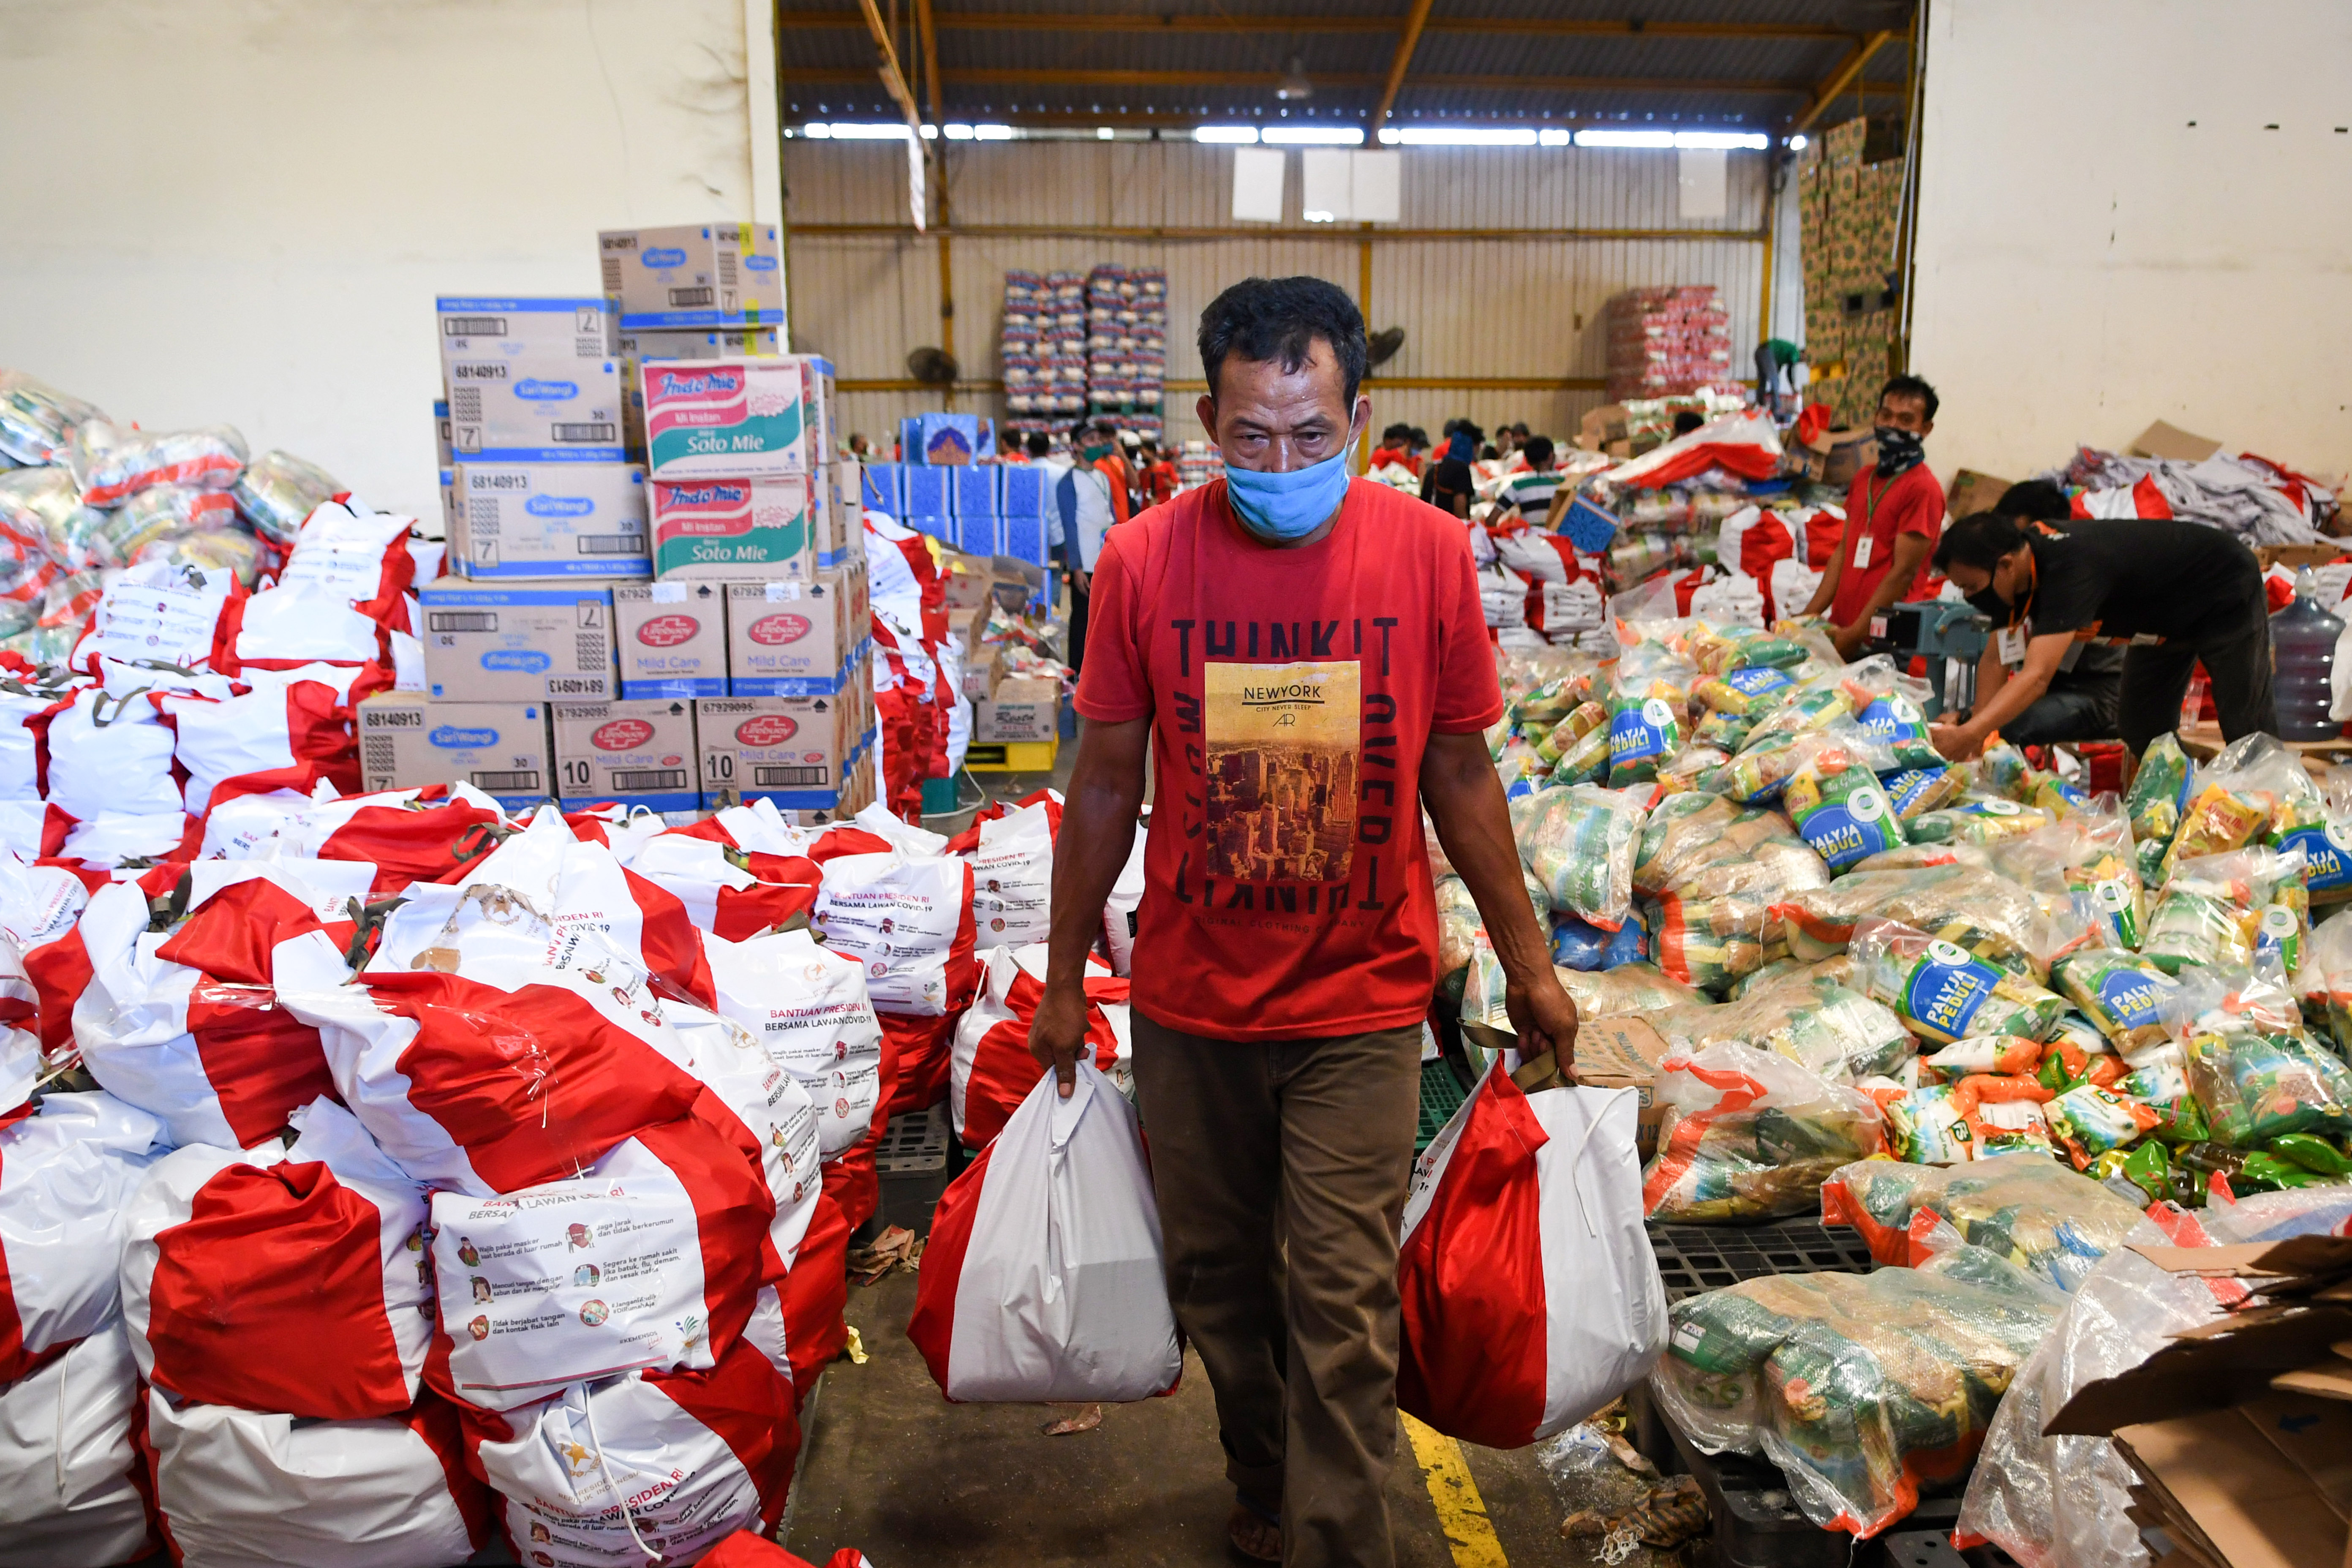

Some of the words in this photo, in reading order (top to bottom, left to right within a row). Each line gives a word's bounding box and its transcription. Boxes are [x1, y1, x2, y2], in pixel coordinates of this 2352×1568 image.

[455, 365, 507, 378] 68140913
[462, 428, 475, 445] 7
[687, 436, 727, 453] Soto
[732, 435, 765, 451] Mie
[471, 475, 528, 489] 68140913
[619, 521, 634, 532] 30
[479, 541, 492, 559] 7
[692, 546, 731, 561] Soto
[735, 546, 768, 561] Mie
[733, 587, 765, 596] 67929
[584, 608, 597, 626] 7
[637, 658, 666, 669] Mild
[669, 656, 701, 669] Care
[747, 655, 776, 667] Mild
[780, 655, 811, 667] Care
[548, 679, 603, 693] 68140913
[703, 702, 754, 713] 67929095
[366, 712, 422, 727] 68140913
[514, 758, 528, 768] 30
[564, 761, 589, 784] 10
[595, 754, 622, 765] Mild
[624, 754, 653, 764] Care
[707, 754, 732, 779] 10
[739, 749, 765, 760] Mild
[768, 749, 796, 760] Care
[373, 779, 388, 791] 7
[1819, 833, 1863, 858] EDULI
[2307, 849, 2338, 866] YJA
[972, 863, 995, 871] AWAN
[997, 860, 1031, 868] COVID-19
[2308, 860, 2341, 877] DULI
[879, 893, 918, 903] PRESIDEN
[829, 899, 866, 909] BERSAMA
[897, 902, 933, 912] COVID-19
[1192, 915, 1240, 926] RIGINAL
[1250, 919, 1309, 934] CLOTHING
[1926, 970, 1968, 1023] PALYJA
[1938, 974, 1979, 1029] PEDULI
[2111, 984, 2159, 1008] PALY
[770, 1007, 822, 1018] BANTUAN
[824, 1003, 860, 1014] PRESIDEN
[765, 1020, 809, 1031] BERSAMA
[768, 1083, 786, 1107] BERSAMA
[610, 1186, 625, 1198] RI
[526, 1195, 577, 1209] LAWAN
[613, 1225, 631, 1234] tidak
[632, 1218, 674, 1231] berkerumun
[614, 1218, 632, 1229] jarak
[477, 1244, 494, 1253] Wajib
[495, 1242, 512, 1252] pakai
[514, 1238, 539, 1248] masker
[493, 1250, 515, 1259] berada
[524, 1246, 538, 1254] luar
[539, 1240, 563, 1251] rumah
[603, 1259, 627, 1269] Segera
[639, 1251, 660, 1261] rumah
[662, 1247, 678, 1257] sakit
[603, 1268, 616, 1277] jika
[618, 1263, 640, 1273] batuk,
[620, 1271, 639, 1279] sesak
[536, 1275, 564, 1285] dengan
[532, 1283, 561, 1293] mengalir
[613, 1301, 655, 1314] #DiRumahAja
[510, 1317, 539, 1328] berjabat
[540, 1313, 565, 1321] tangan
[506, 1325, 528, 1333] kontak
[619, 1331, 658, 1344] #KEMENSOS
[671, 1467, 684, 1482] RI
